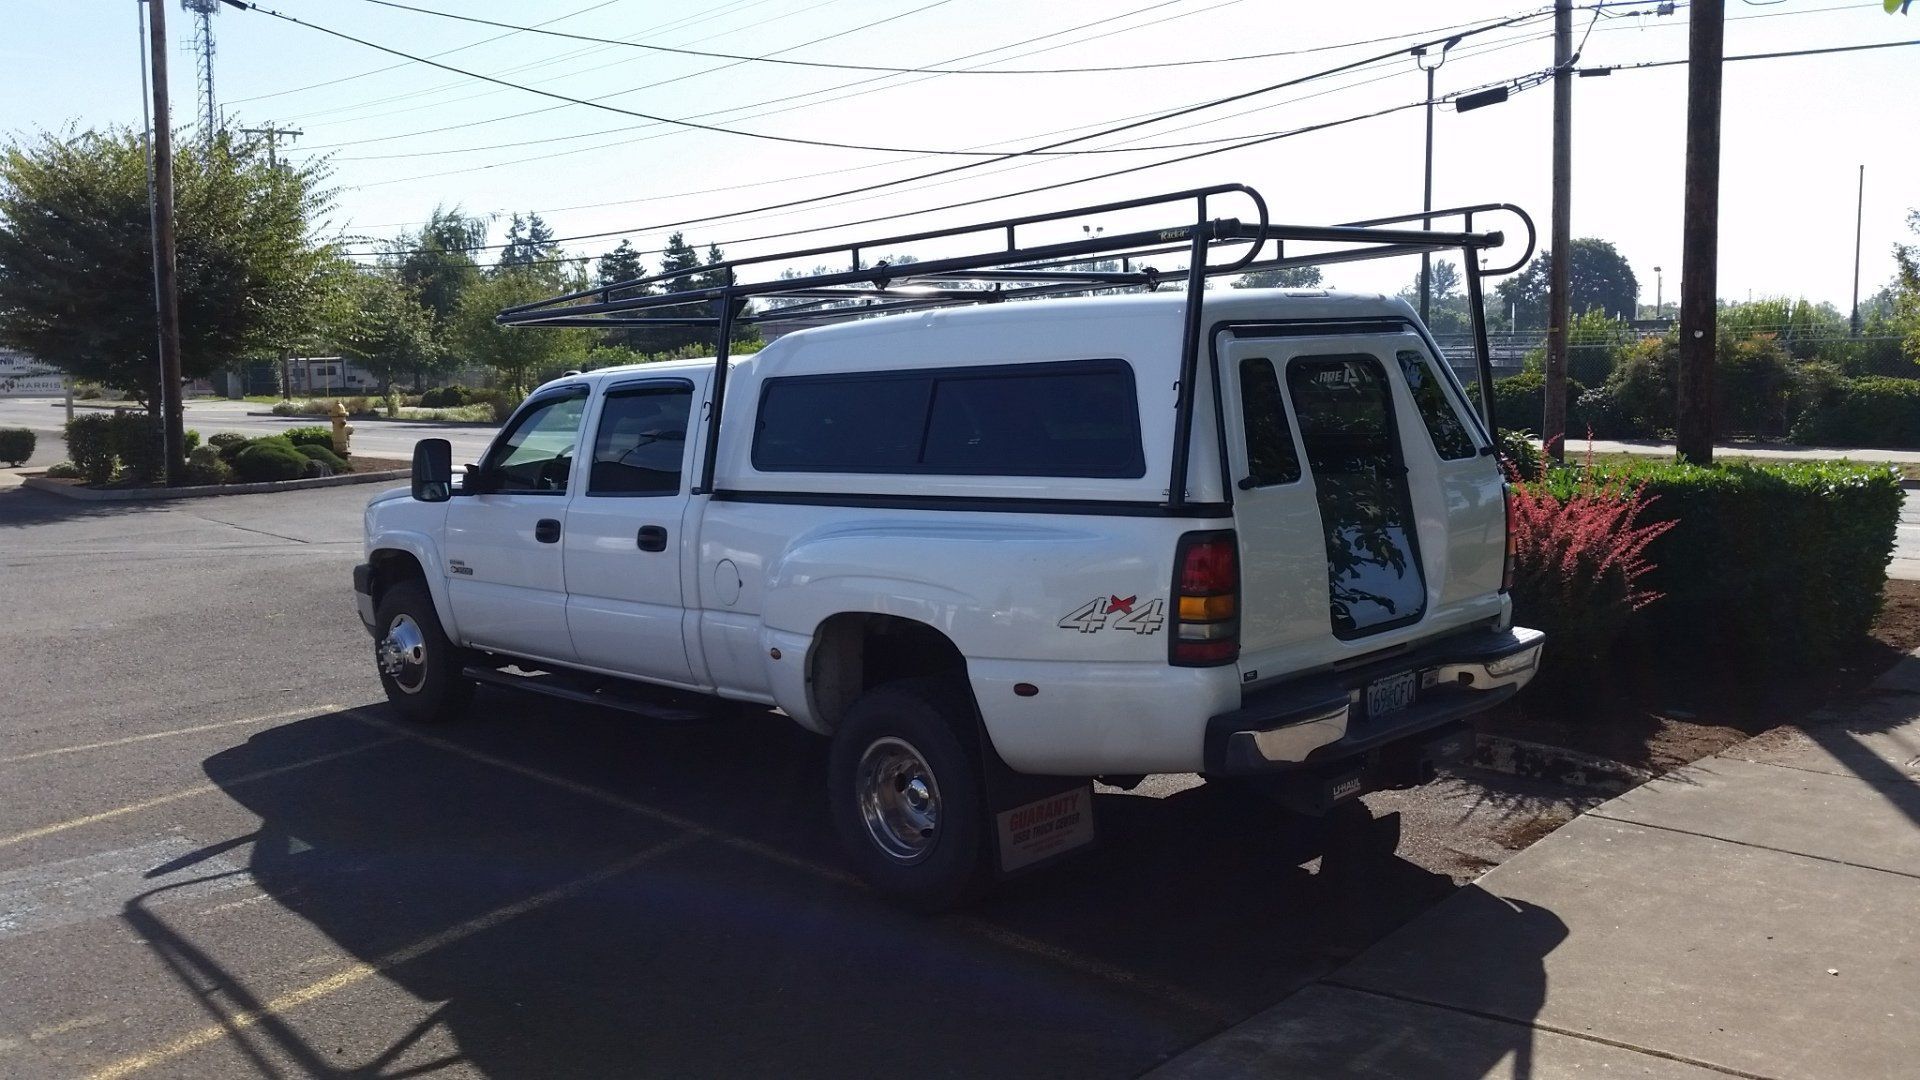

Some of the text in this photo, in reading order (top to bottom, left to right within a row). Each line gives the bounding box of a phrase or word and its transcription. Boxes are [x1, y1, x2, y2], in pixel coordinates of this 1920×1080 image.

[1010, 792, 1079, 832] GUARANTY
[1013, 829, 1030, 846] USED
[1033, 820, 1054, 840] TRUCK
[1055, 812, 1081, 830] CENTER
